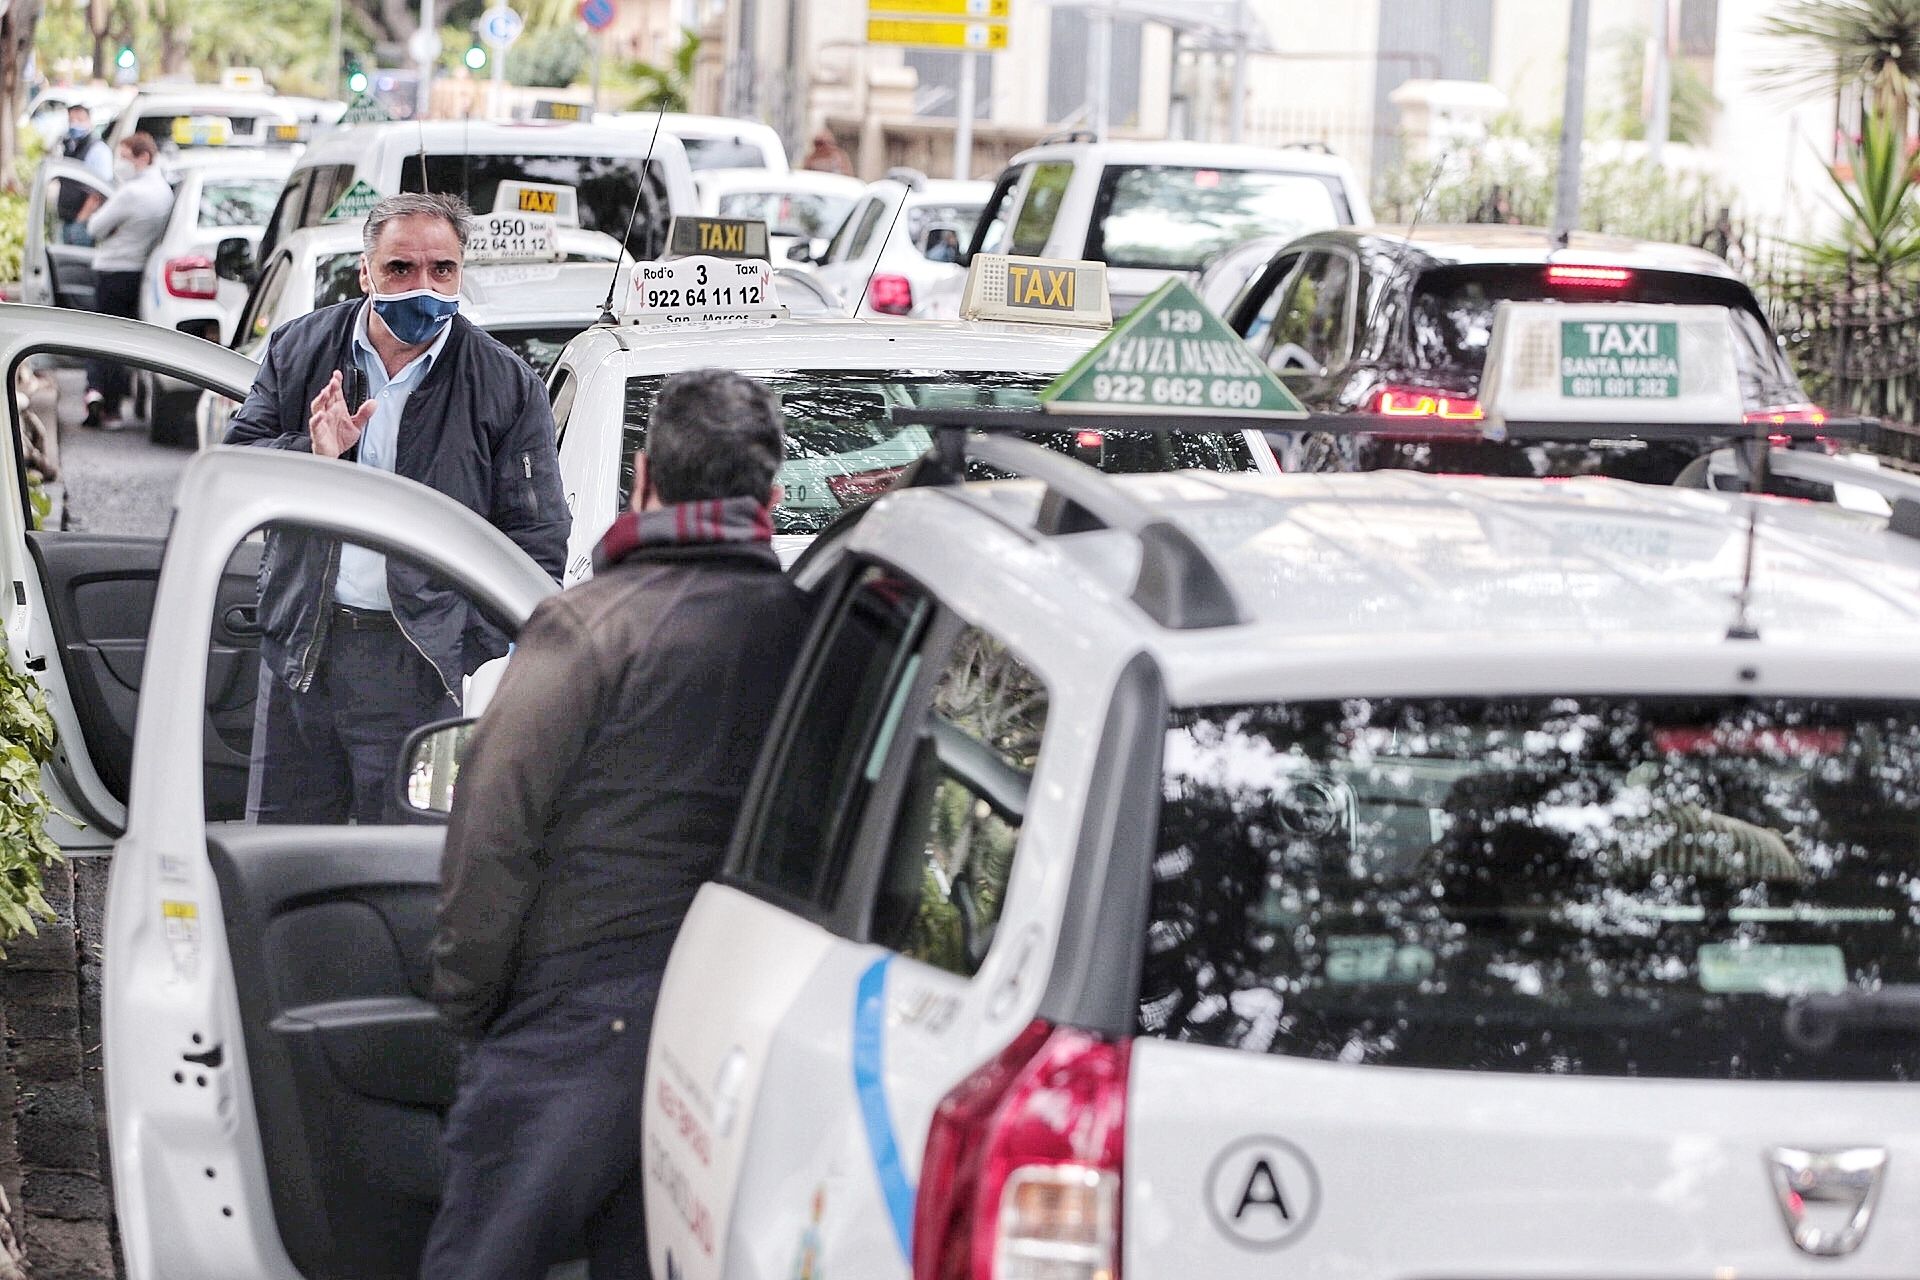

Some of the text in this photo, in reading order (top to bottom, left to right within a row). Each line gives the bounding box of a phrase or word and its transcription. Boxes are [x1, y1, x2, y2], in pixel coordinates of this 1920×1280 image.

[519, 189, 556, 213] TAXI
[490, 219, 526, 236] 950
[699, 223, 745, 250] TAXI
[492, 238, 507, 250] 64
[512, 238, 526, 250] 11
[531, 238, 546, 250] 12
[696, 265, 708, 285] 3
[735, 264, 758, 275] Taxi
[648, 287, 760, 308] 922 64 11 12
[1010, 267, 1074, 307] TAXI
[1157, 309, 1203, 333] 129
[1582, 323, 1658, 355] TAXI
[1561, 356, 1620, 377] SANTA
[1093, 374, 1262, 408] 922 662 660
[1235, 1160, 1288, 1219] A
